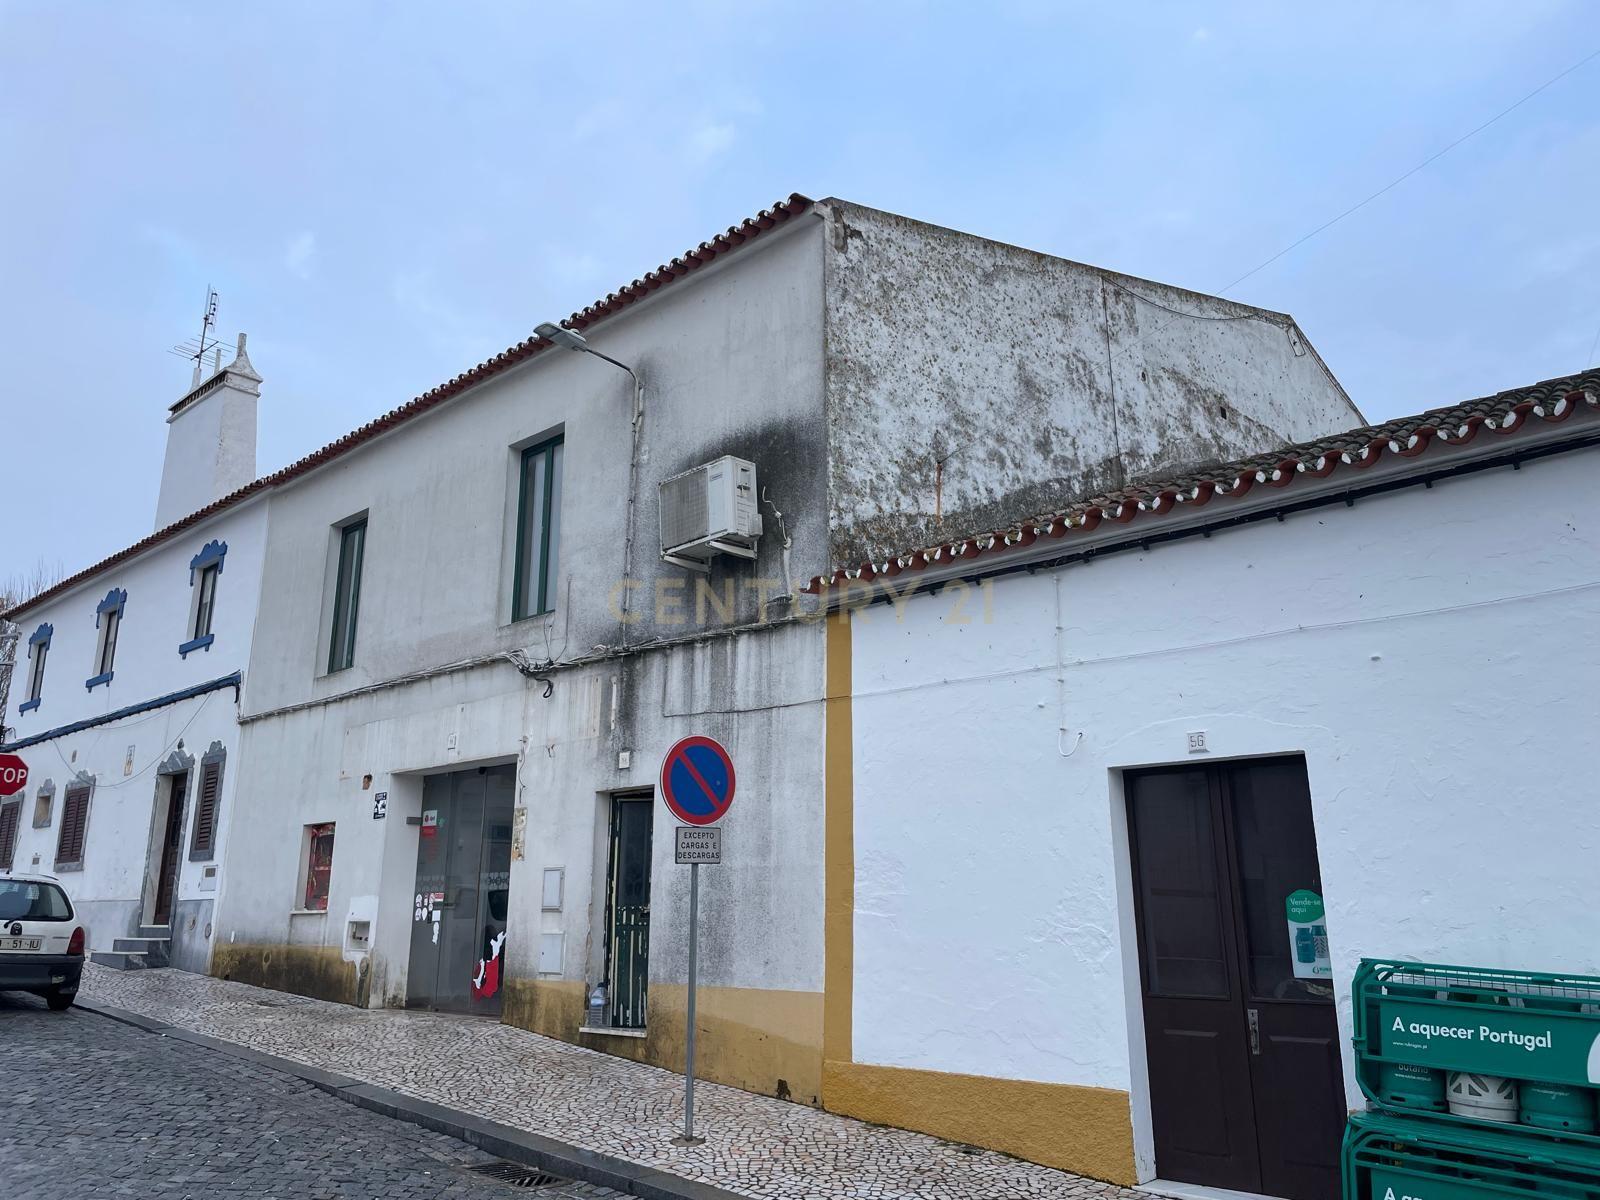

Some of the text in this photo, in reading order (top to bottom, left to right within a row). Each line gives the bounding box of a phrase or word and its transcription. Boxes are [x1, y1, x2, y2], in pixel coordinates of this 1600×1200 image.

[1190, 735, 1203, 747] 56
[1291, 907, 1306, 915] aqui
[1392, 1017, 1552, 1051] A aquecer Portugal
